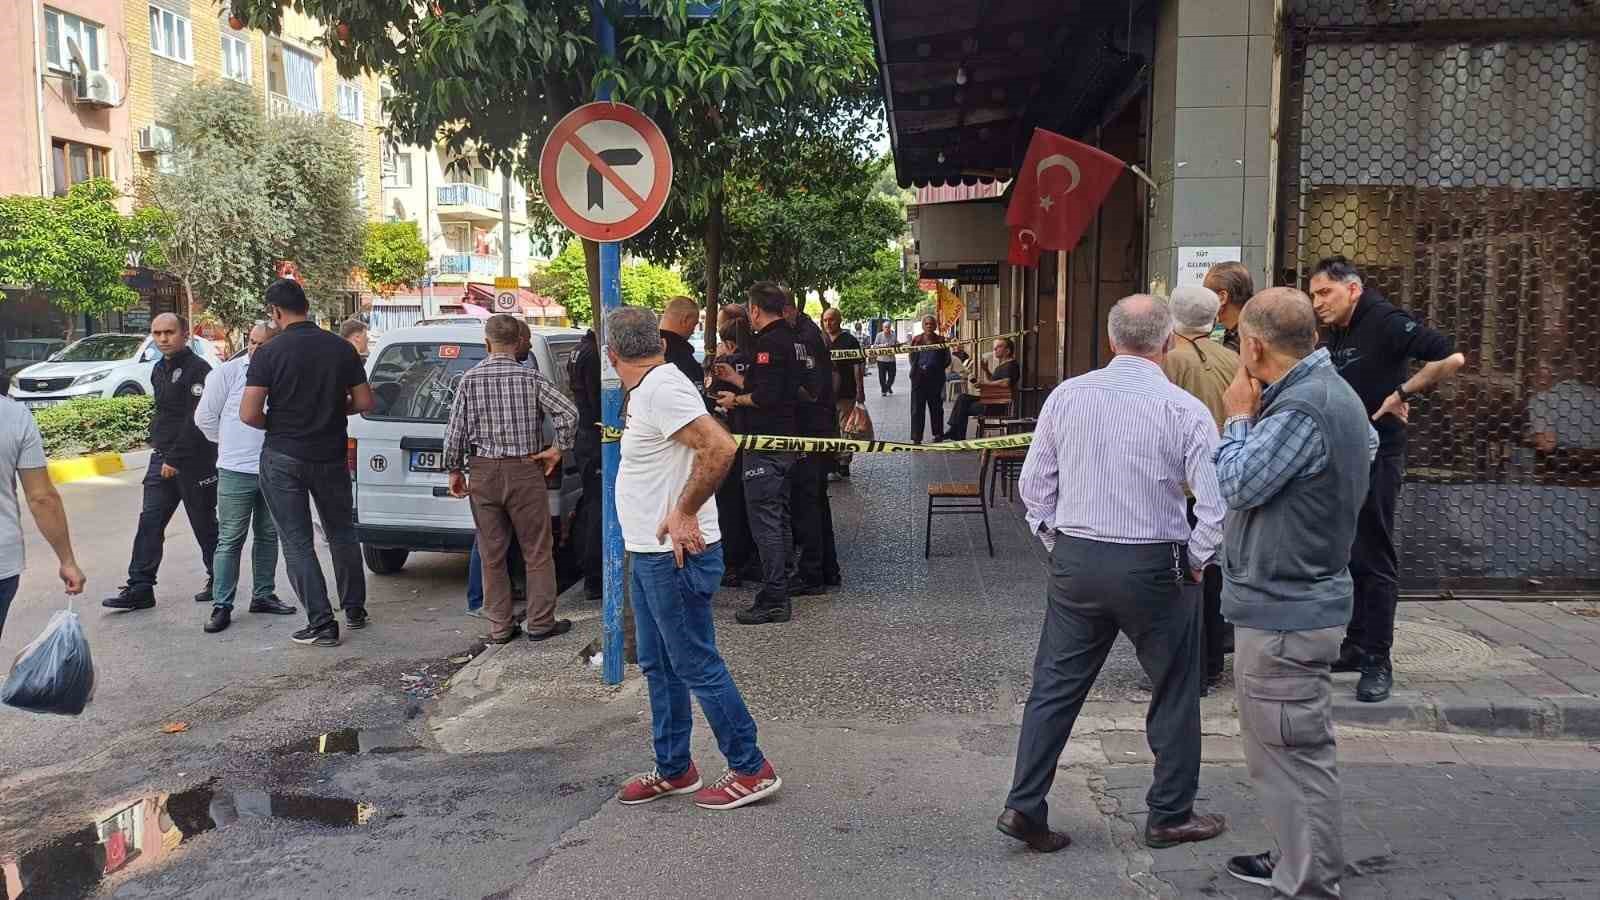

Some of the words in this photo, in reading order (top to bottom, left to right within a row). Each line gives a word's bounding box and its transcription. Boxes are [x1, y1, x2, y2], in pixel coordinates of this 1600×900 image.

[501, 296, 513, 305] 30
[373, 457, 385, 469] TR
[418, 453, 435, 467] 09
